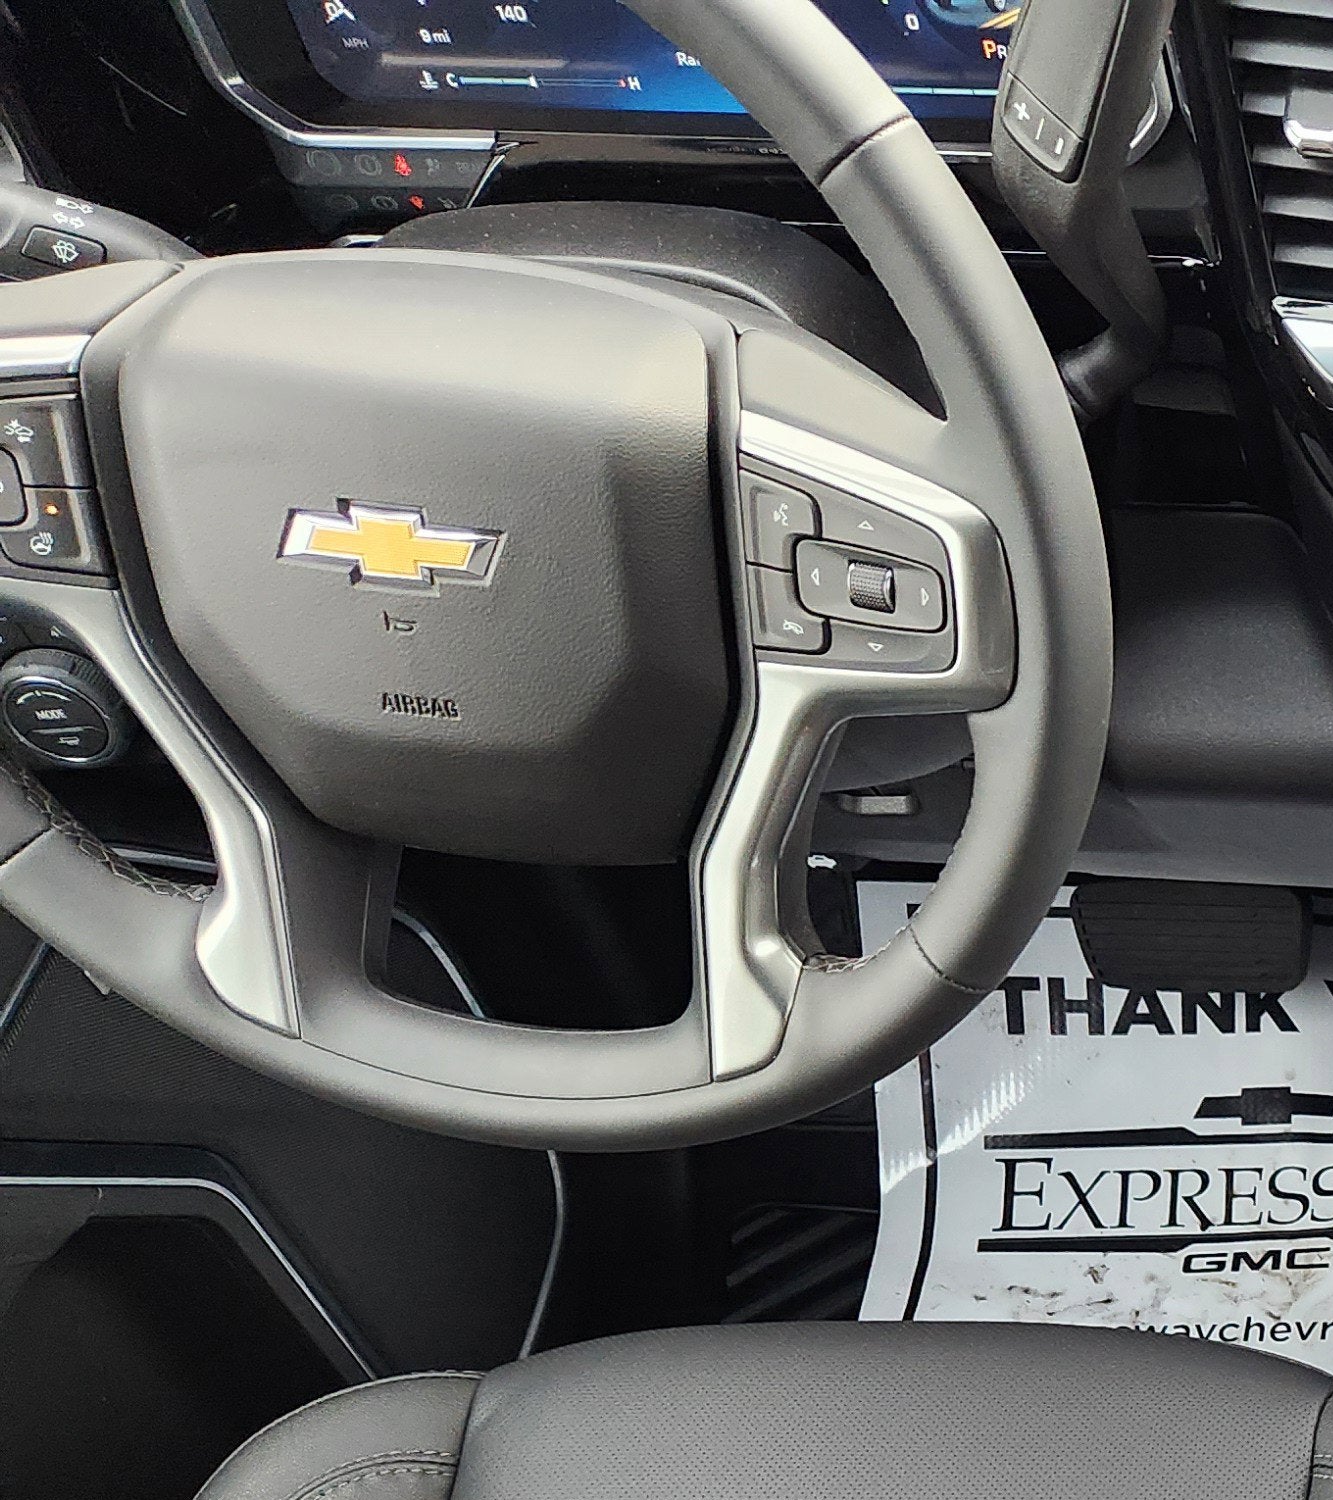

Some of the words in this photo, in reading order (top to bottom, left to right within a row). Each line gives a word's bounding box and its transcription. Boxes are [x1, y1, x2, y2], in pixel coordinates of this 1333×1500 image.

[495, 4, 528, 23] 140
[904, 13, 920, 31] 0
[342, 36, 369, 50] MPH
[432, 28, 452, 44] mi
[446, 72, 459, 89] C
[628, 76, 642, 91] H
[35, 708, 67, 720] MODE
[381, 691, 460, 720] AIRBAG
[998, 976, 1302, 1036] THANK
[1181, 1246, 1333, 1273] GMC
